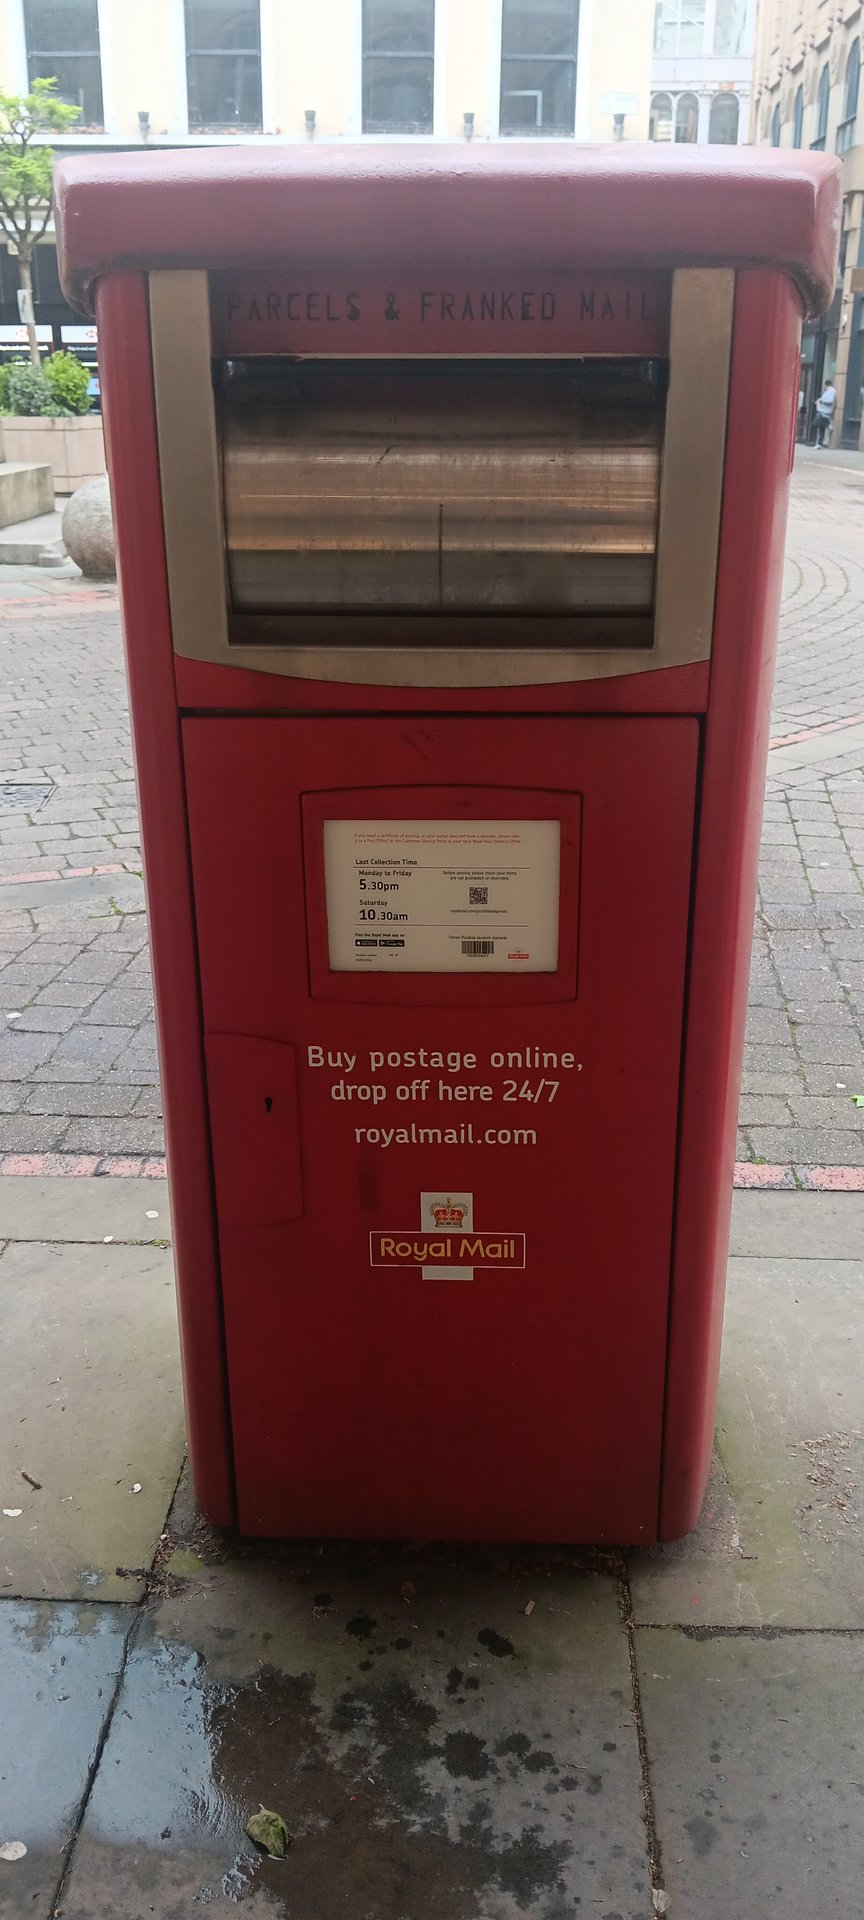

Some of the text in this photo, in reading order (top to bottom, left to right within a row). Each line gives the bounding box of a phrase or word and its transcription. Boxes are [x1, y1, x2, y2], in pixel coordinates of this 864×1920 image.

[227, 291, 654, 321] PARCELS & FRANKED MAIL
[359, 878, 399, 892] 5.30pm
[359, 909, 408, 920] 10.30am
[307, 1045, 583, 1072] Buy postage online,
[330, 1078, 560, 1104] drop off here 24/7
[354, 1123, 538, 1148] royalmail.com
[380, 1238, 515, 1262] Royal Mail
